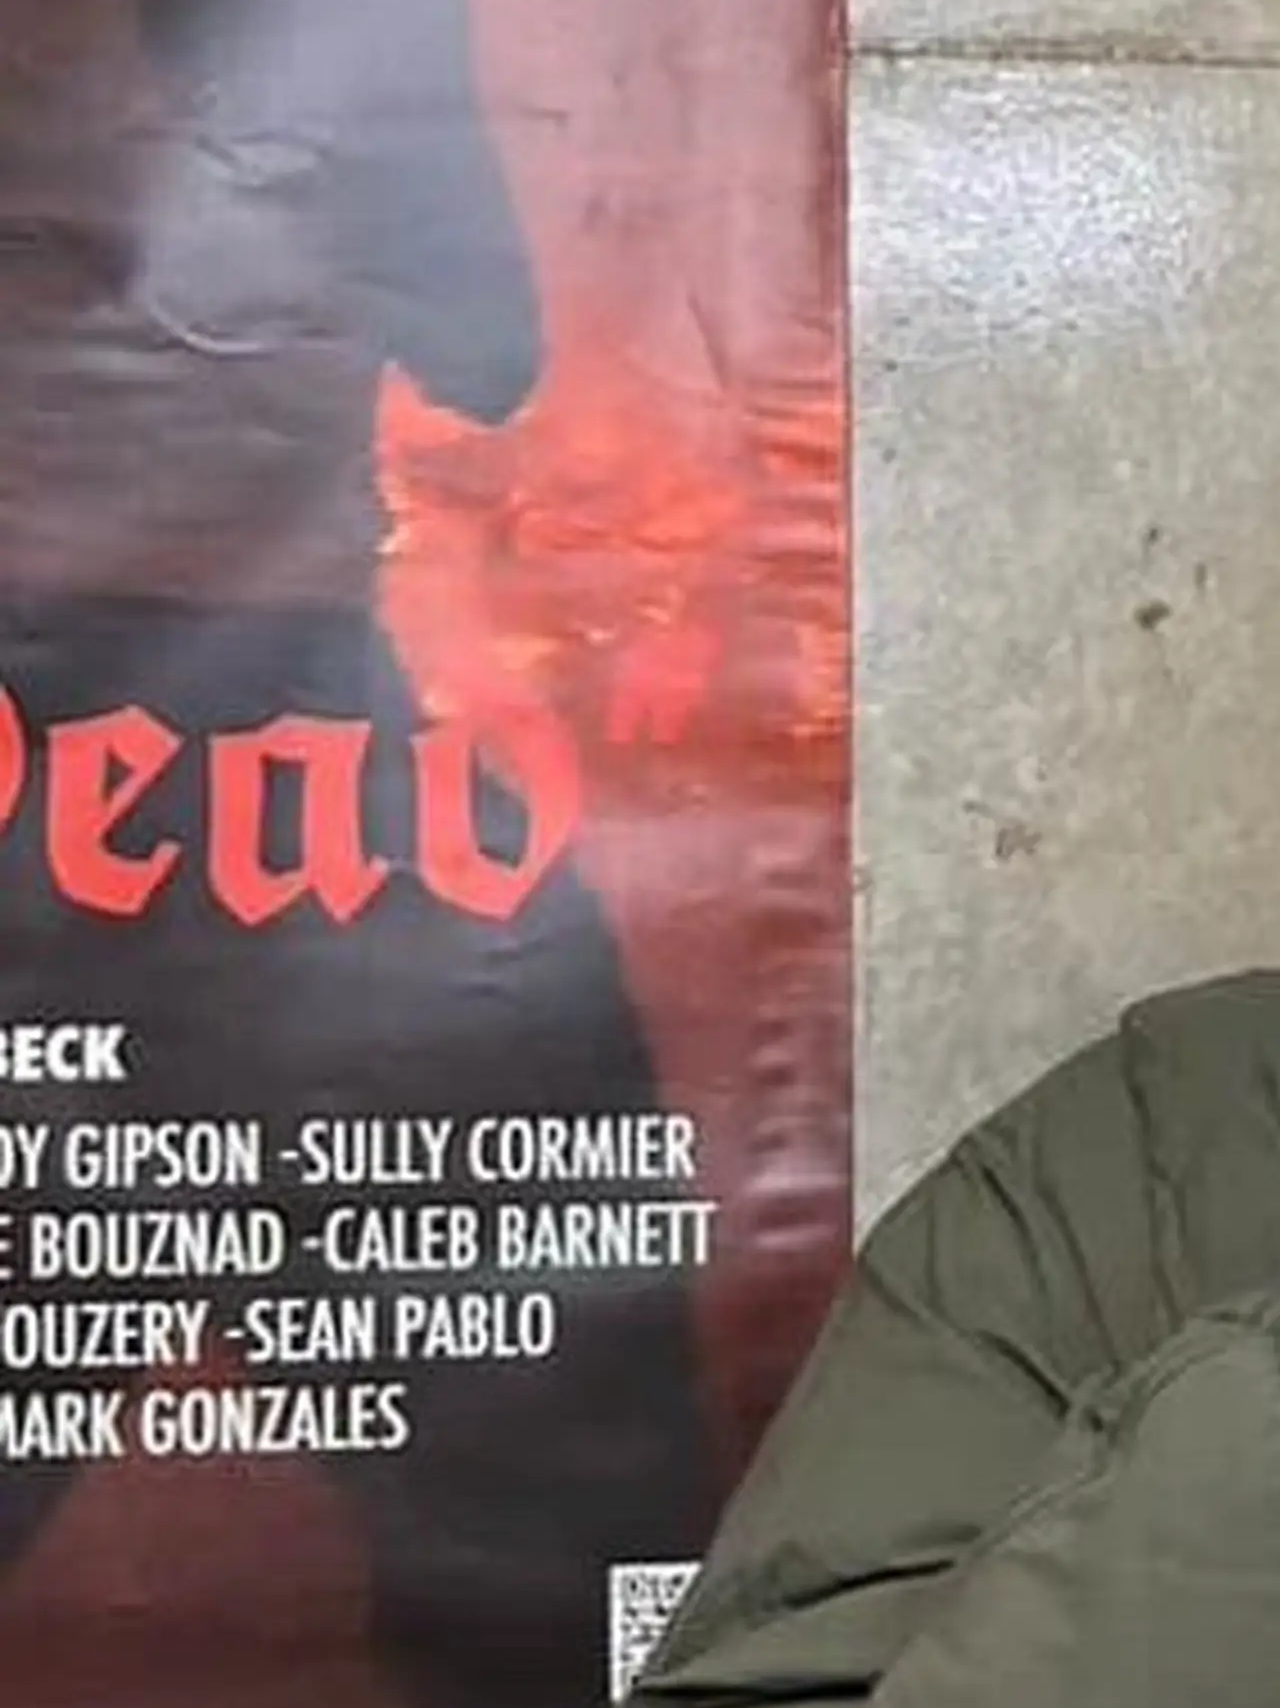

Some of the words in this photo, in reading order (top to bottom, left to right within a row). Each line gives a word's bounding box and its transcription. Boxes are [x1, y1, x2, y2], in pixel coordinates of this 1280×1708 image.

[0, 1026, 124, 1081] ECK
[65, 1123, 259, 1187] GIPSON
[469, 1115, 696, 1181] CORMIER
[32, 1211, 283, 1277] BOUZNAD
[498, 1201, 719, 1270] BARNETT
[396, 1293, 553, 1358] PABLO
[141, 1384, 407, 1455] GONZALES
